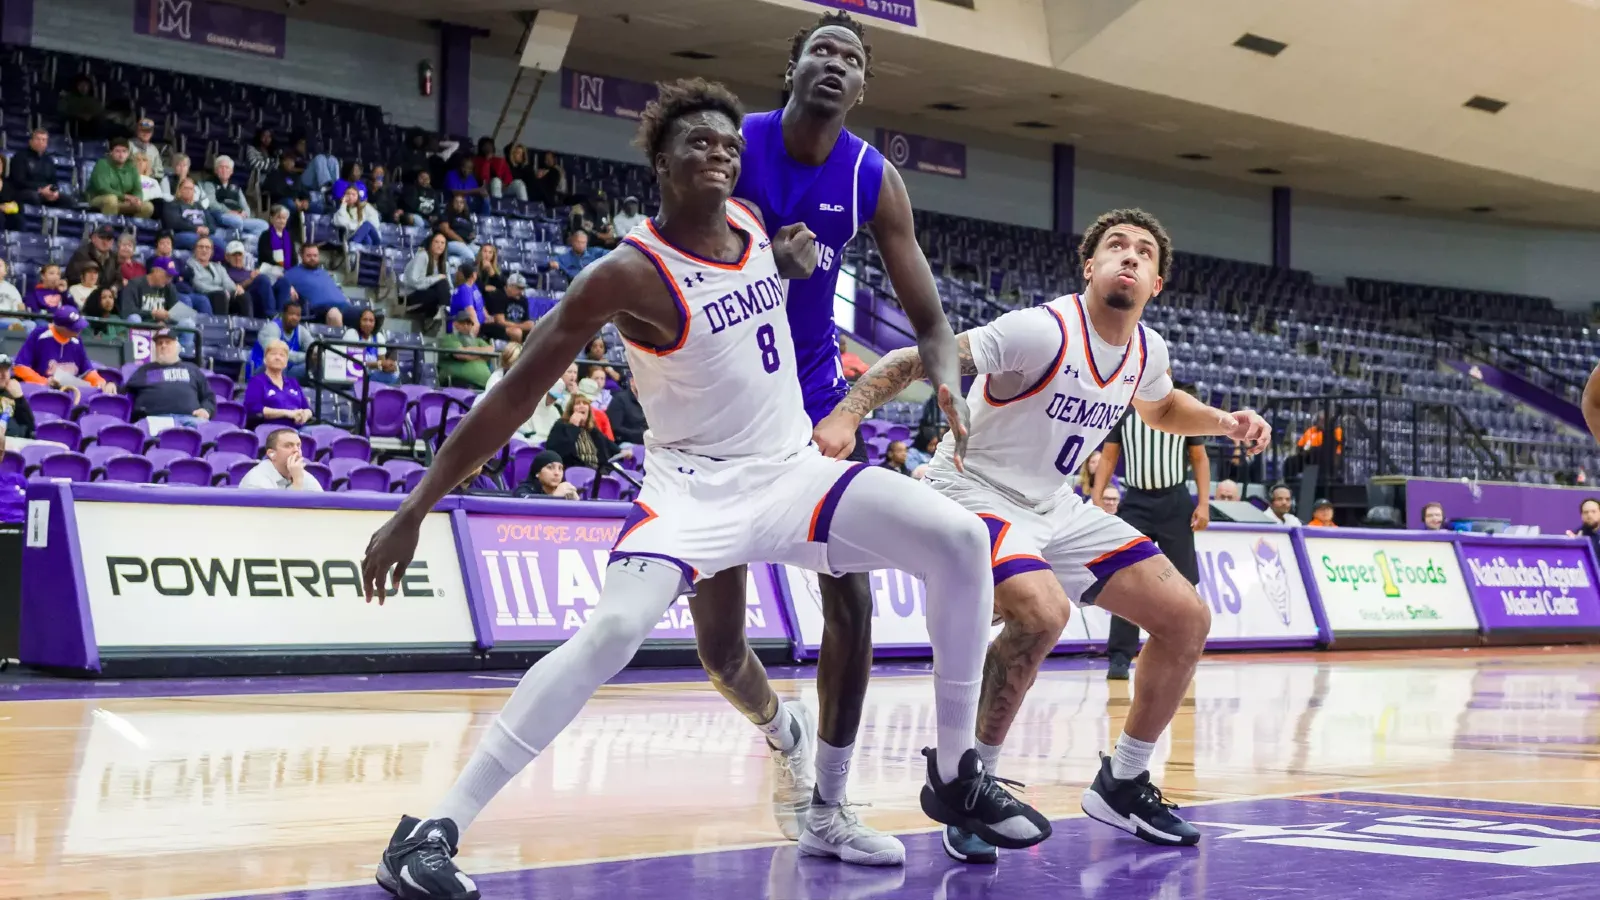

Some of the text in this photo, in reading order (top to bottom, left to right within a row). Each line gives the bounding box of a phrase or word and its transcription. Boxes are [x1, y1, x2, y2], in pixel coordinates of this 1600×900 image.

[158, 0, 192, 39] M
[580, 75, 604, 112] N
[131, 336, 151, 360] B
[756, 323, 781, 374] 8
[1054, 434, 1085, 476] 0
[575, 525, 622, 543] ALW
[1322, 555, 1377, 591] Super
[1391, 558, 1447, 584] Foods
